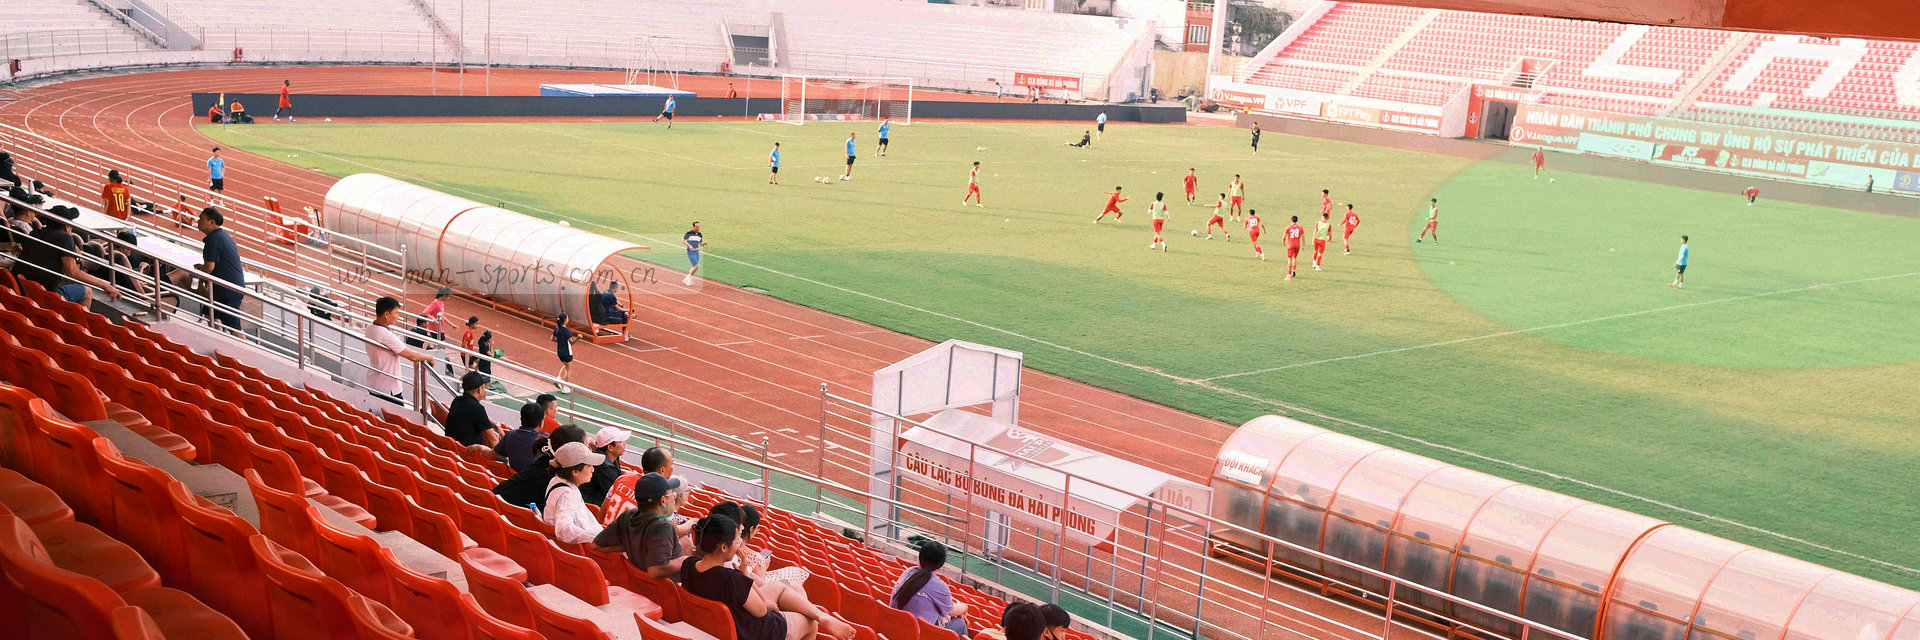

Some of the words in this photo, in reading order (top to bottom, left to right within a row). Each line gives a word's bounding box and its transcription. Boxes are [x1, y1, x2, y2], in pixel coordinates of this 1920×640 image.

[1287, 98, 1308, 108] VPF
[1526, 110, 1557, 126] NHÂN
[1560, 113, 1584, 129] DÂN
[1587, 117, 1625, 134] THÀNH
[1627, 121, 1653, 138] PHỐ
[1654, 126, 1696, 143] CHUNG
[1700, 131, 1720, 146] TAY
[1722, 130, 1750, 149] ỨNG
[1753, 136, 1771, 154] HỘ
[1775, 139, 1796, 157] SỰ
[1797, 140, 1833, 159] PHÁT
[1836, 144, 1877, 164] TRIỂN
[1879, 147, 1909, 167] CỦA
[113, 194, 125, 211] 10
[1290, 228, 1300, 239] 28
[616, 483, 626, 493] FC
[906, 452, 928, 476] CÂU
[930, 461, 951, 486] LẠC
[955, 470, 969, 495] BỘ
[973, 478, 1005, 503] BÓNG
[1008, 490, 1024, 510] ĐÁ
[1028, 494, 1048, 520] HẢI
